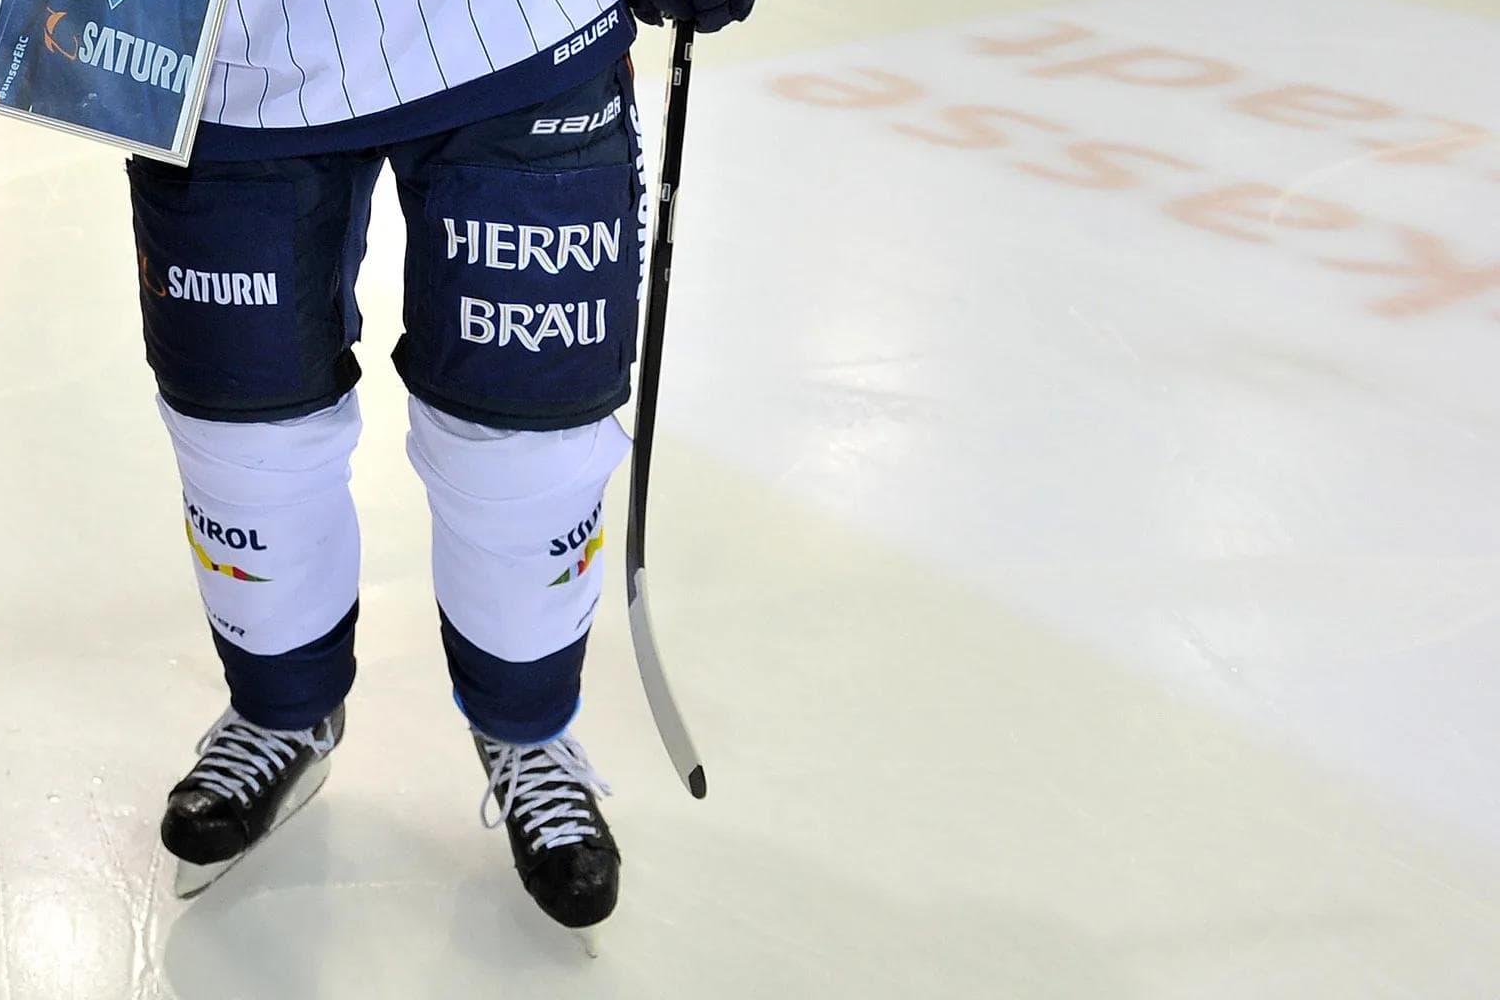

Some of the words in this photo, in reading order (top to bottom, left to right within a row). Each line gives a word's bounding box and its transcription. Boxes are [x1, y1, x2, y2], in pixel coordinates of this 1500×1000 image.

[444, 217, 622, 275] HERRN
[167, 264, 279, 307] SATURN
[460, 296, 607, 353] BRÄU
